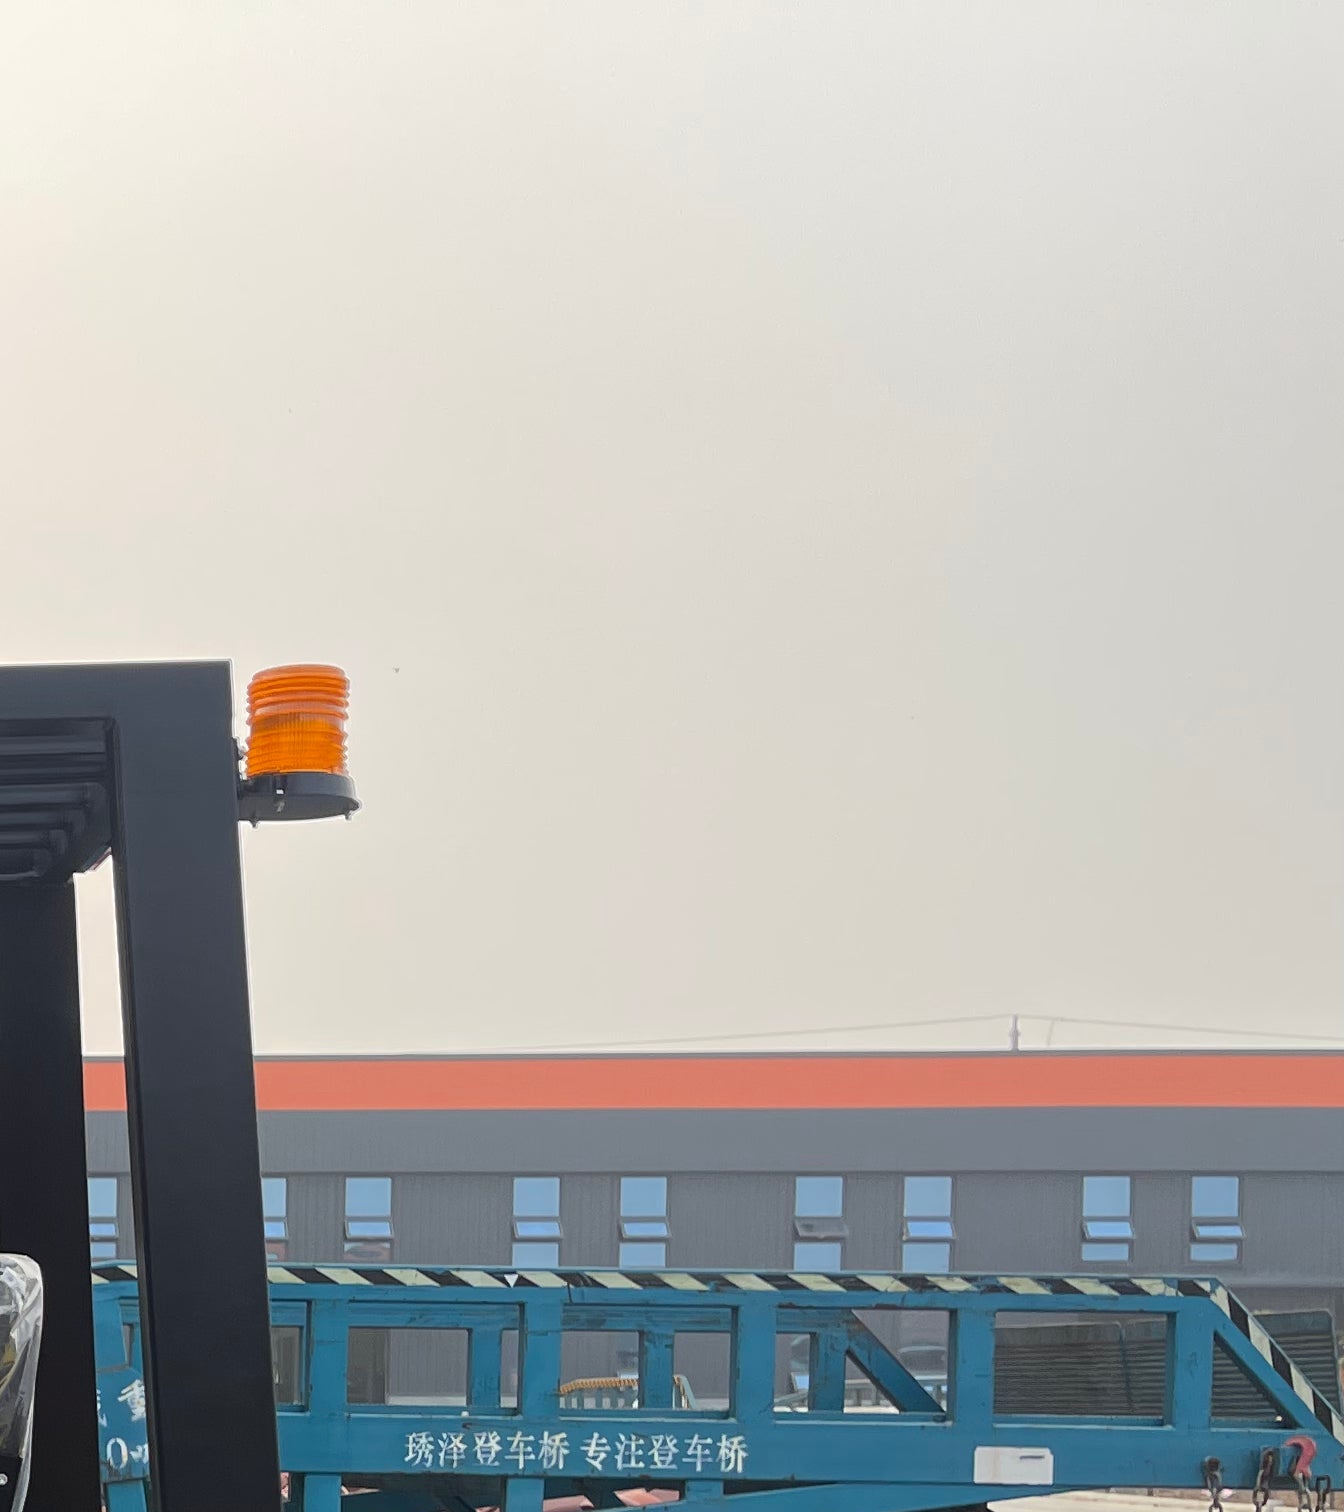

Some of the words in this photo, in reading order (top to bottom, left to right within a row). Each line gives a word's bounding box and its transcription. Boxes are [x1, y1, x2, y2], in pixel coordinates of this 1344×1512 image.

[404, 1430, 570, 1471] 琇泽登车桥
[580, 1432, 748, 1473] 专注登车桥
